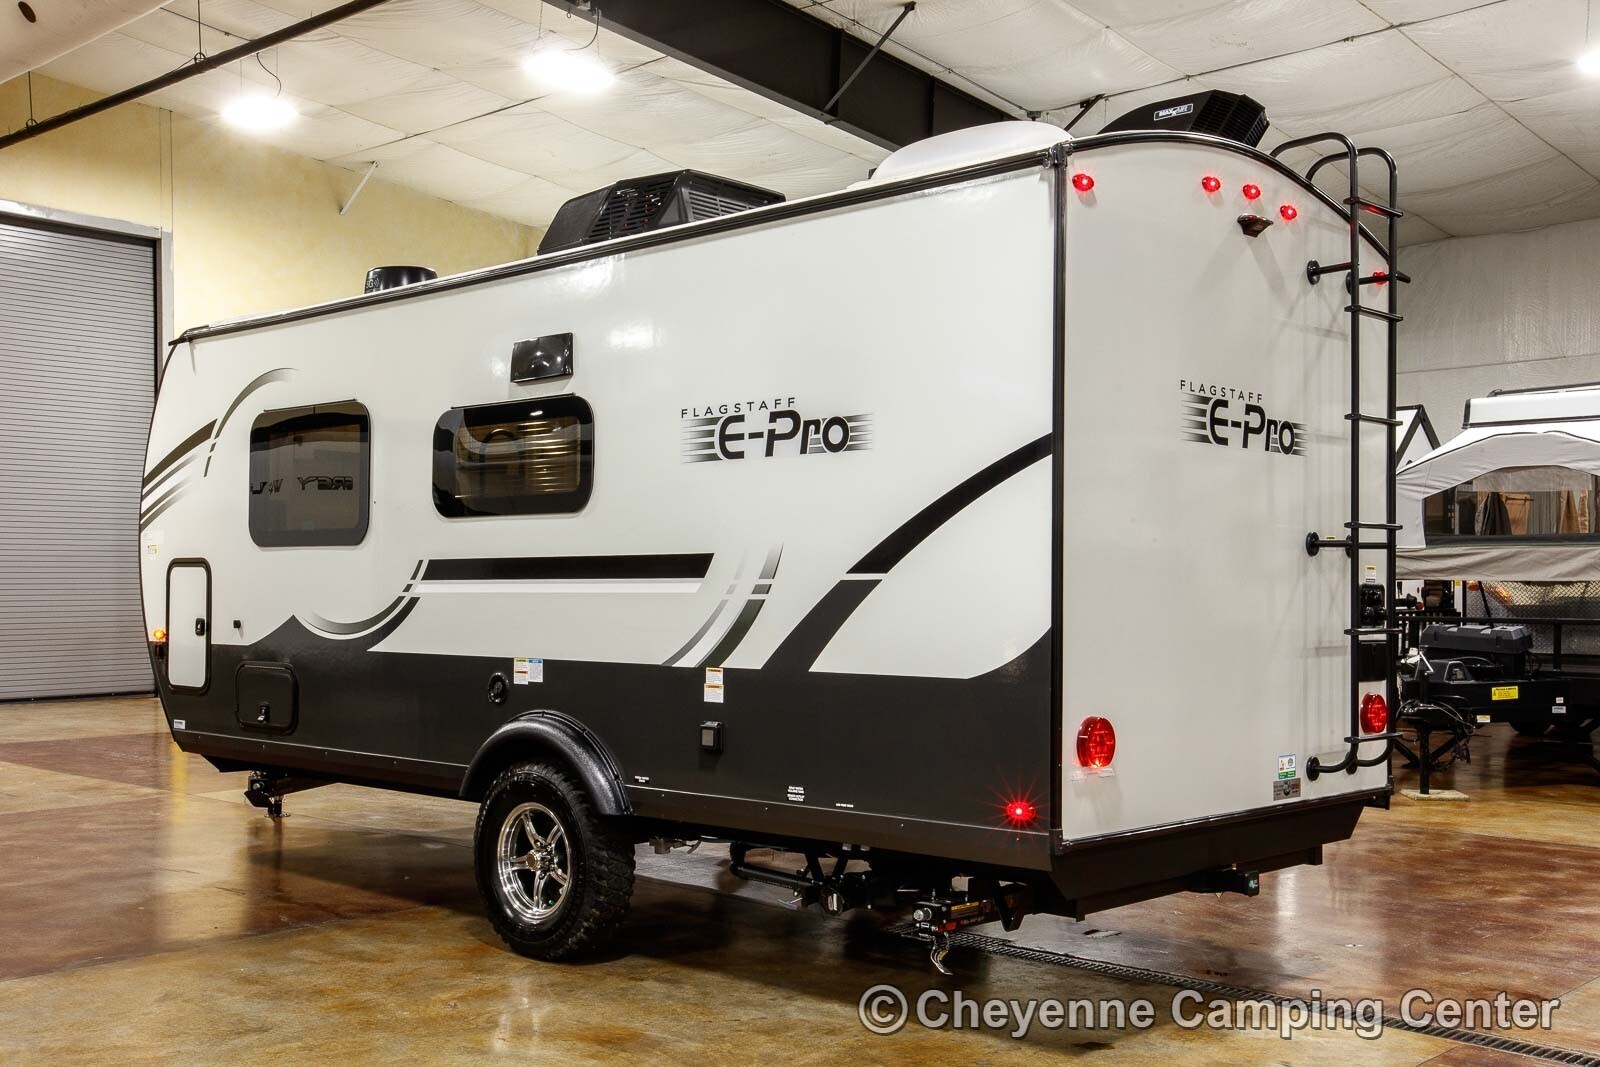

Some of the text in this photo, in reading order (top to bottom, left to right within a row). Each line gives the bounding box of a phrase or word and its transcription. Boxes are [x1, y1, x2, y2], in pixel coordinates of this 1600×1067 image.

[681, 397, 796, 419] FLAGSTAFF
[1180, 379, 1264, 404] FLAGSTAFF
[718, 409, 850, 459] E-Pro
[1209, 398, 1296, 455] E-Pro
